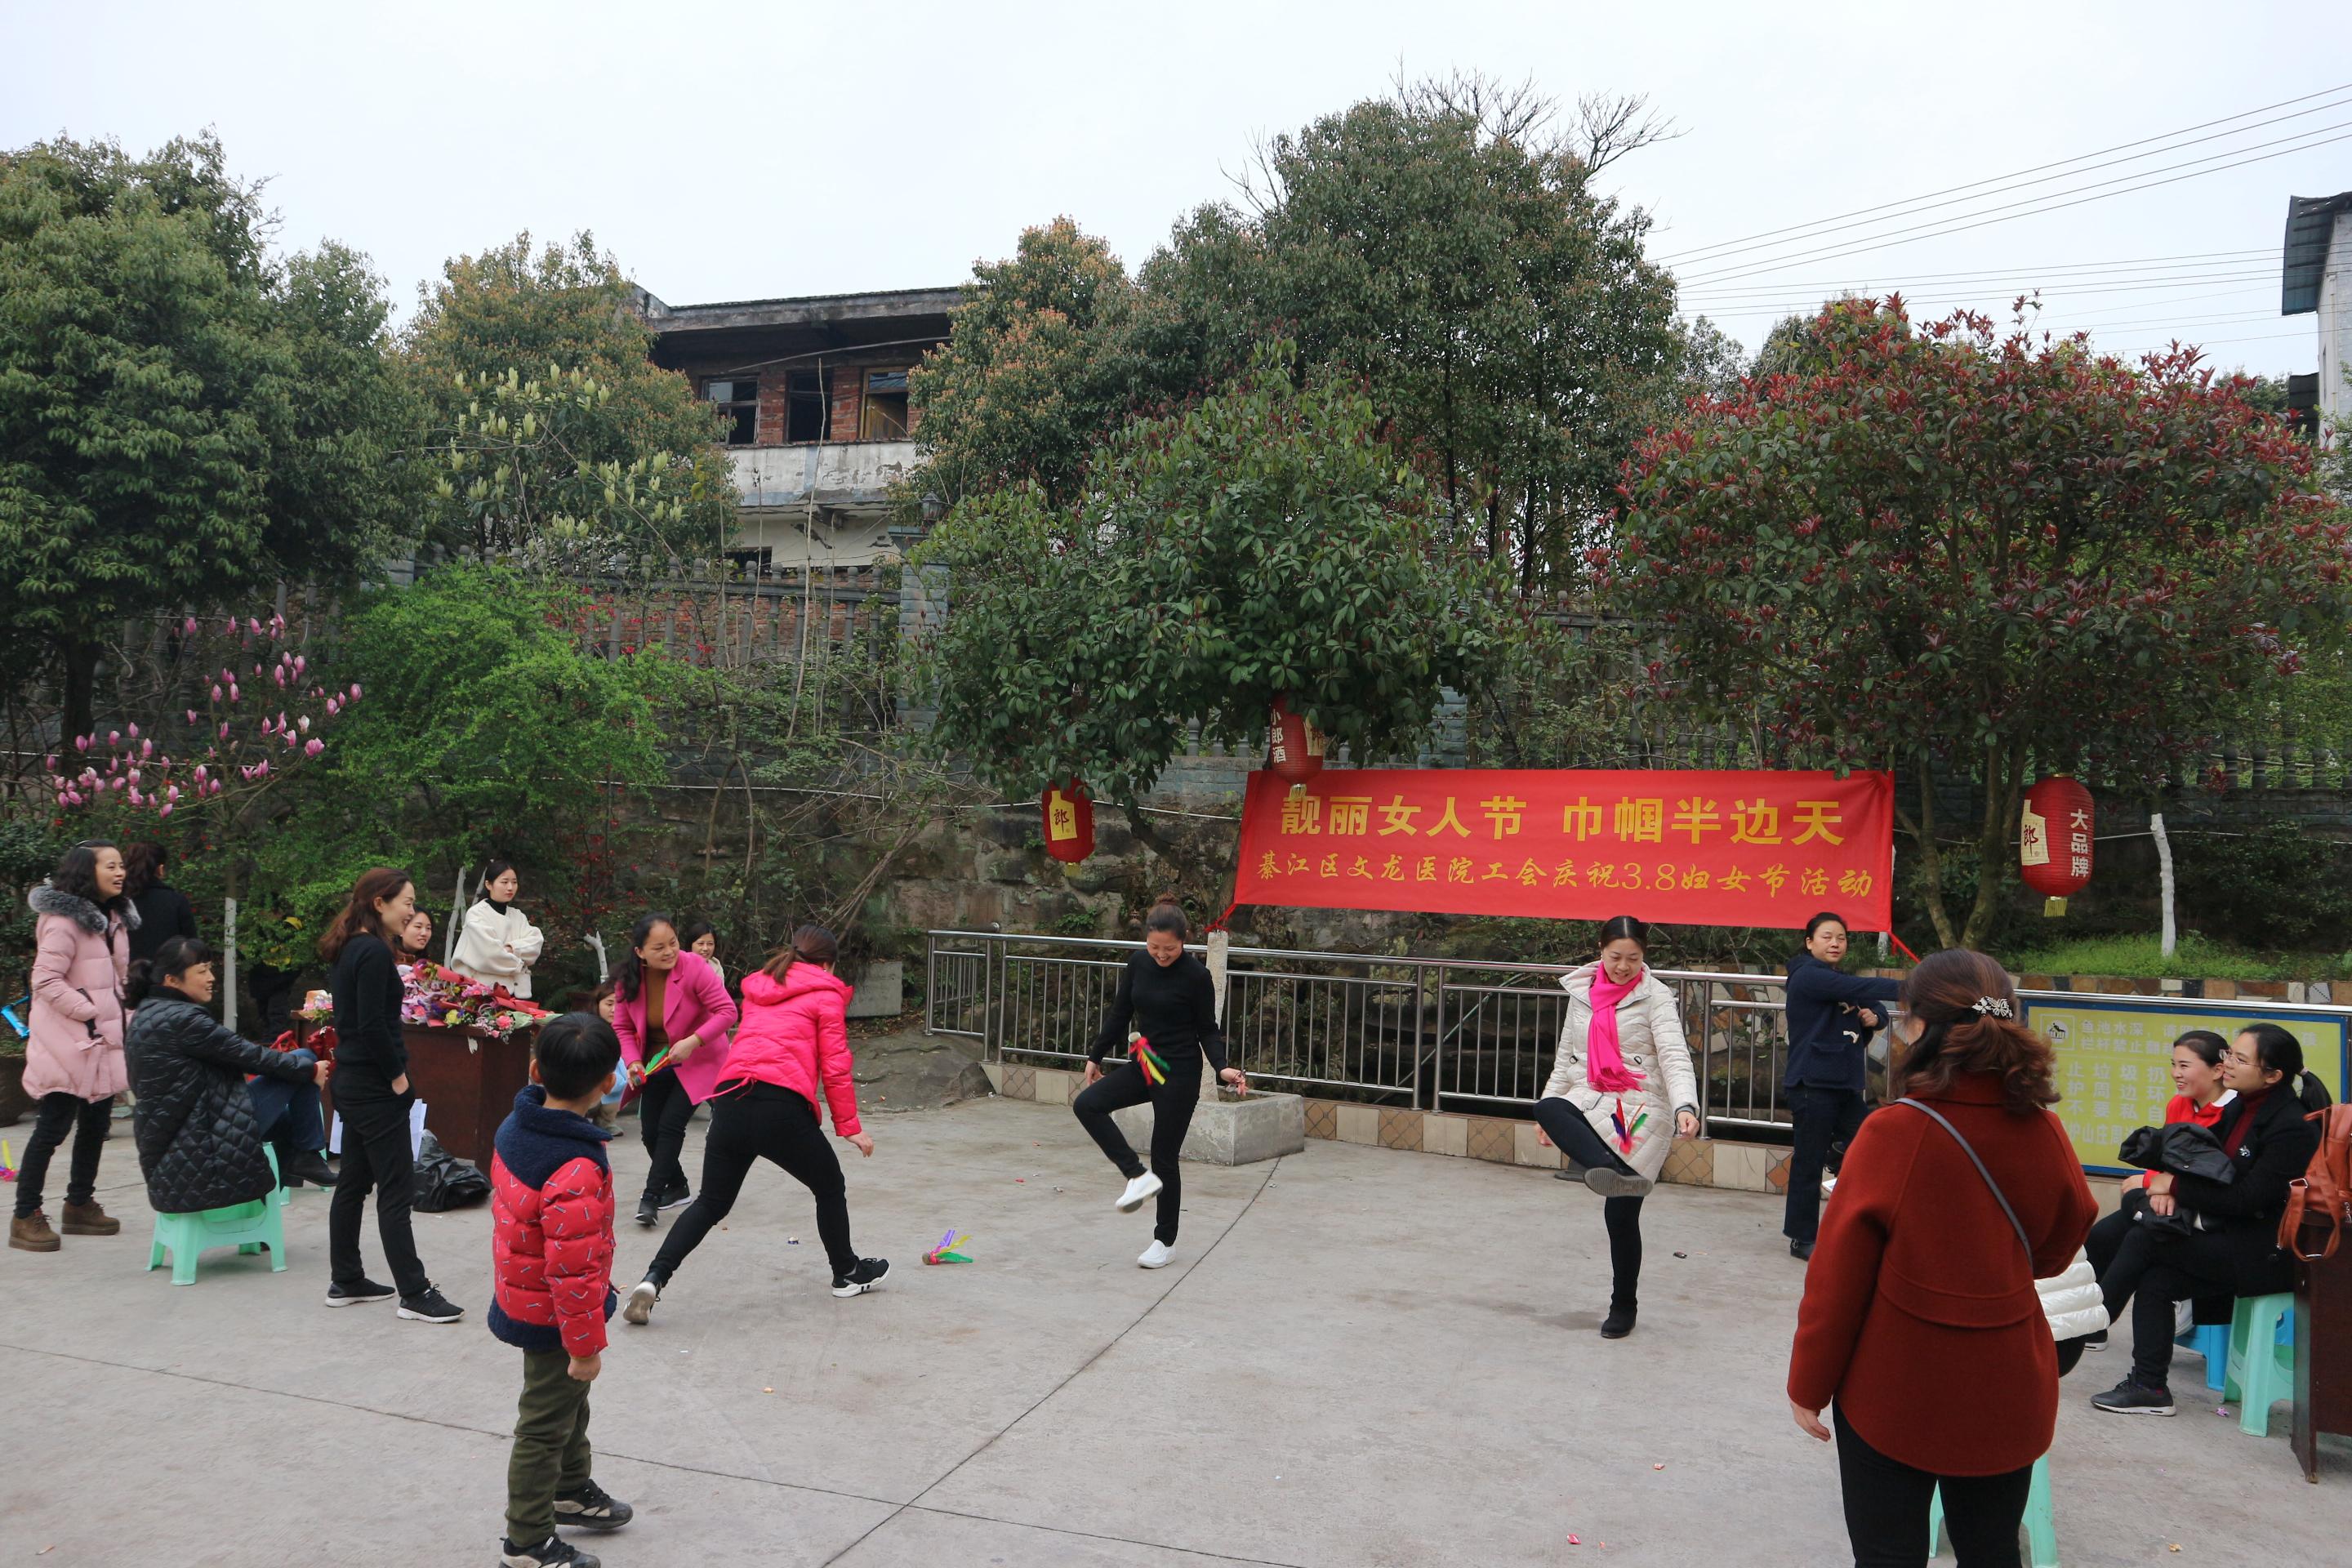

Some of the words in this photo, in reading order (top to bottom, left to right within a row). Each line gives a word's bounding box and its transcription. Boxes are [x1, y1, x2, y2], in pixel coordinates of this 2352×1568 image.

[1281, 795, 1526, 840] 靓丽女人节
[1562, 796, 1845, 845] 巾帼半边天
[2070, 808, 2090, 878] 大品牌
